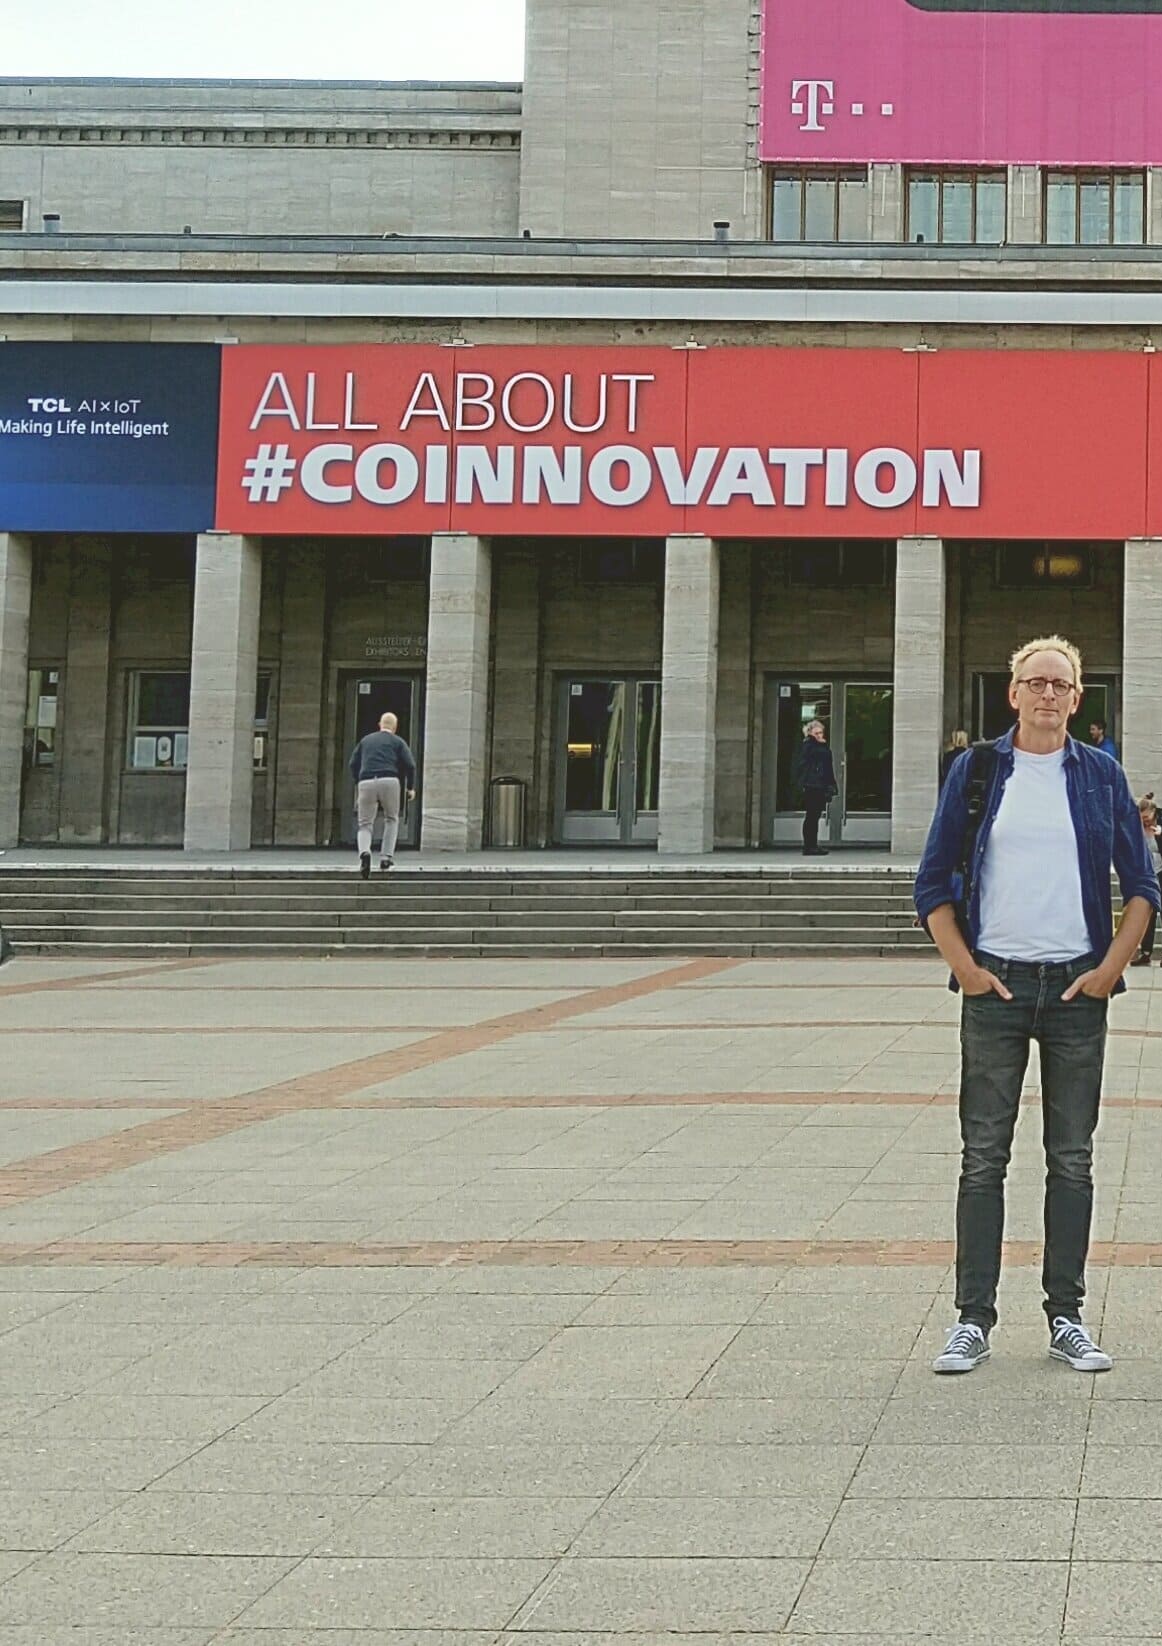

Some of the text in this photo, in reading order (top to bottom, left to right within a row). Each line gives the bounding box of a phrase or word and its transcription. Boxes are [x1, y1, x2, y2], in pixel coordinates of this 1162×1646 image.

[28, 398, 71, 412] TCL
[249, 371, 655, 434] ALL ABOUT
[0, 419, 169, 437] Making Life Intelligent
[241, 443, 981, 508] #COINNOVATION
